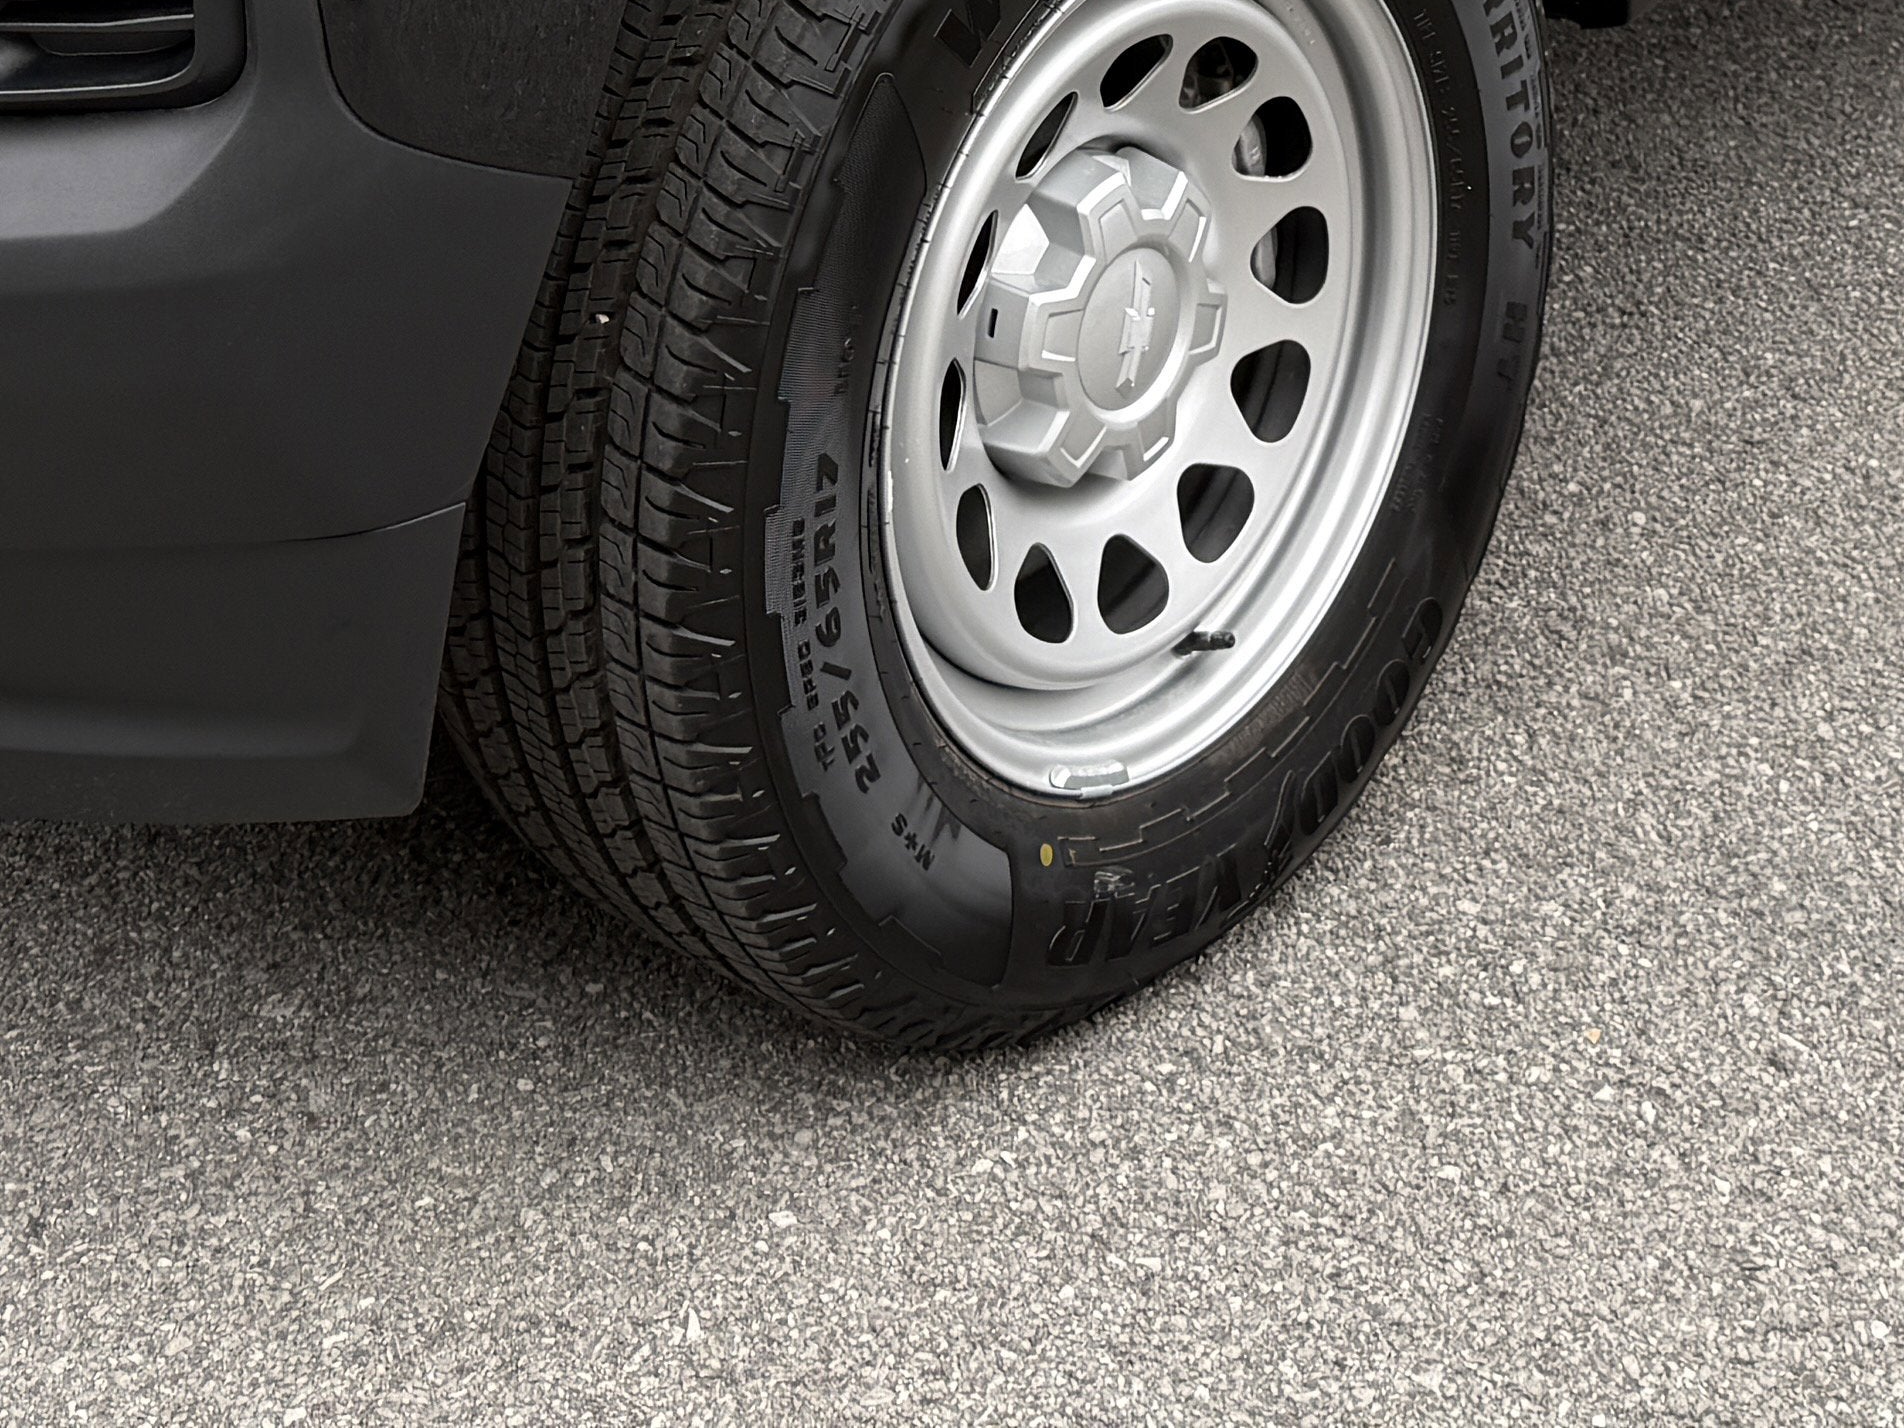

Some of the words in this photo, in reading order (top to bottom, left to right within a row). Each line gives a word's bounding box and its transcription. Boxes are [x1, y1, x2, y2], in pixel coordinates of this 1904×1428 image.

[813, 452, 882, 795] 255/65R17
[1045, 597, 1445, 967] GOODYEAR
[891, 811, 936, 872] M+S
